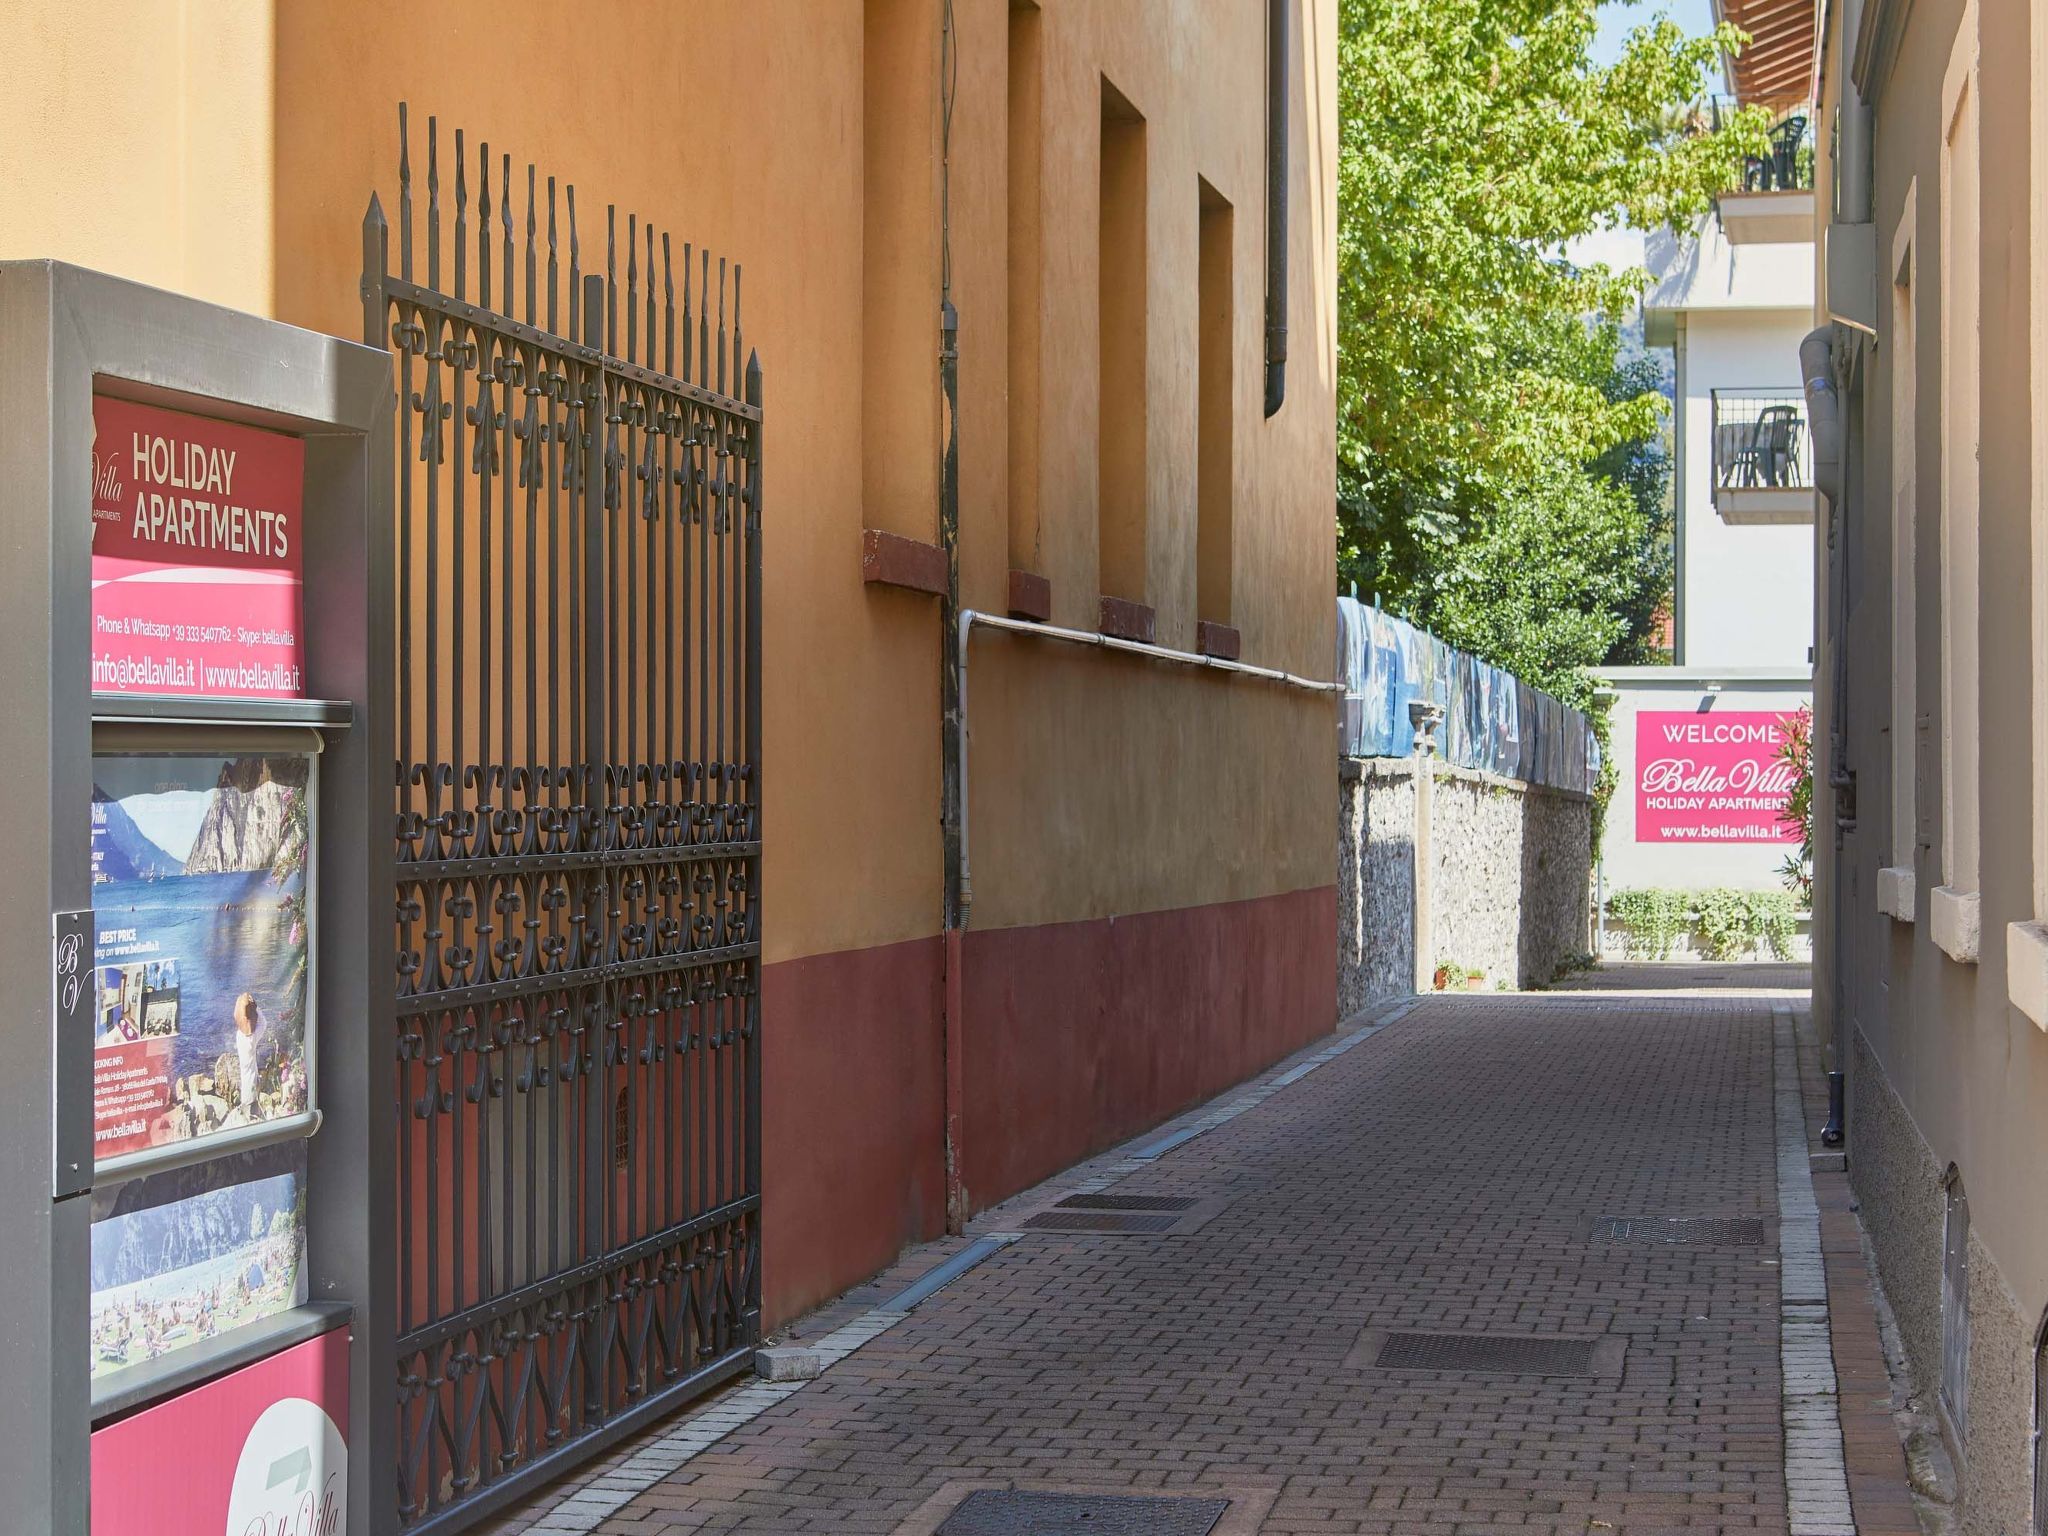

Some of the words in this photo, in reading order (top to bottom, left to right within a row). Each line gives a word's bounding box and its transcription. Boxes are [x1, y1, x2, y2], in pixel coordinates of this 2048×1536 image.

[133, 432, 236, 496] HOLIDAY
[132, 491, 288, 558] APARTMENTS
[97, 615, 123, 634] Phone
[124, 618, 130, 633] &
[131, 618, 171, 639] Whatsapp
[172, 626, 185, 640] +39
[186, 627, 200, 642] 333
[200, 626, 232, 643] 5407762
[237, 629, 262, 648] Skype:
[92, 653, 195, 688] info@bellavilla.it
[206, 661, 300, 691] www.bellavilla.it
[1662, 724, 1781, 744] WELCOME
[1641, 758, 1729, 794] Bella
[1646, 797, 1705, 810] HOLIDAY
[1708, 797, 1790, 810] APARTMENT
[1660, 824, 1782, 839] www.bellavilla.it
[99, 930, 118, 945] BEST
[118, 928, 137, 942] PRICE
[95, 1118, 147, 1142] www.bellavilla.it
